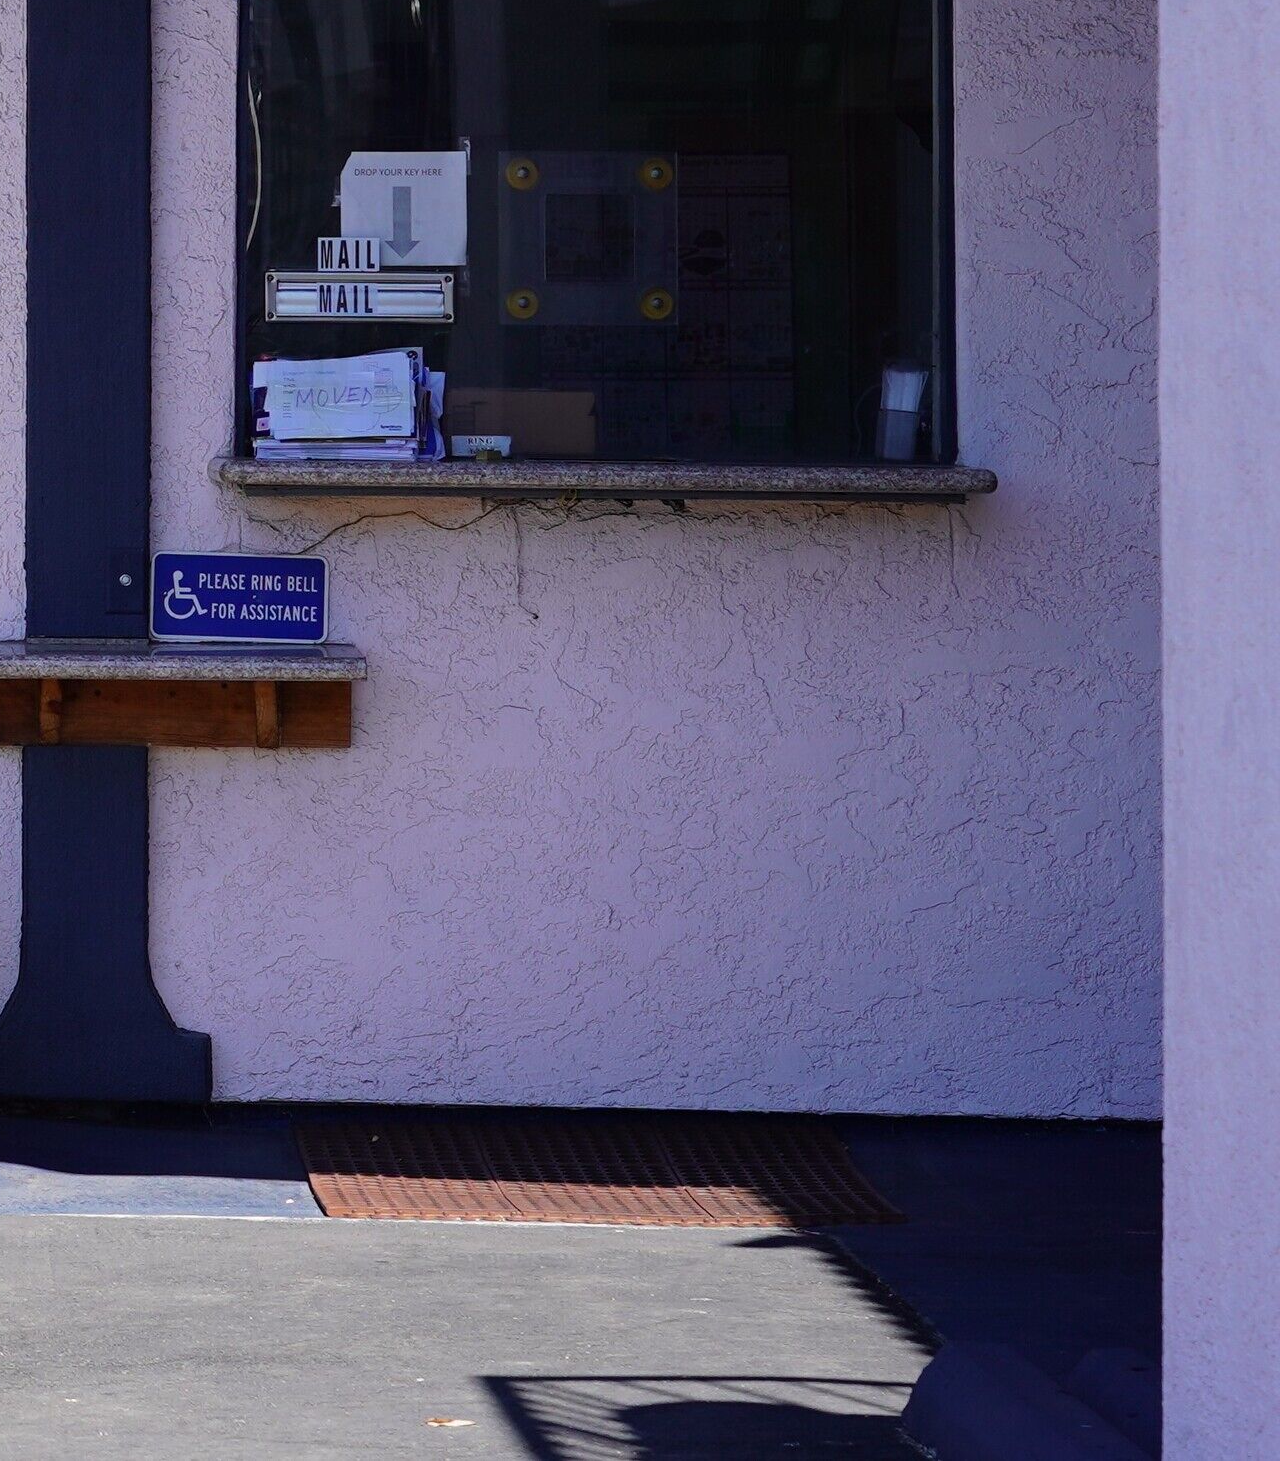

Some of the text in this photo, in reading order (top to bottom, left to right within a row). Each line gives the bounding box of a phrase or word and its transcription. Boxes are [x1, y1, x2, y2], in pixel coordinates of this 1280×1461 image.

[354, 168, 443, 177] DROP YOUR KEY HERE
[320, 240, 375, 269] MAIL
[319, 285, 373, 314] MAIL
[295, 387, 373, 408] MOVED
[467, 437, 493, 445] RING
[198, 573, 318, 593] PLEASE RING BELL
[211, 603, 318, 622] FOR ASSISTANCE
